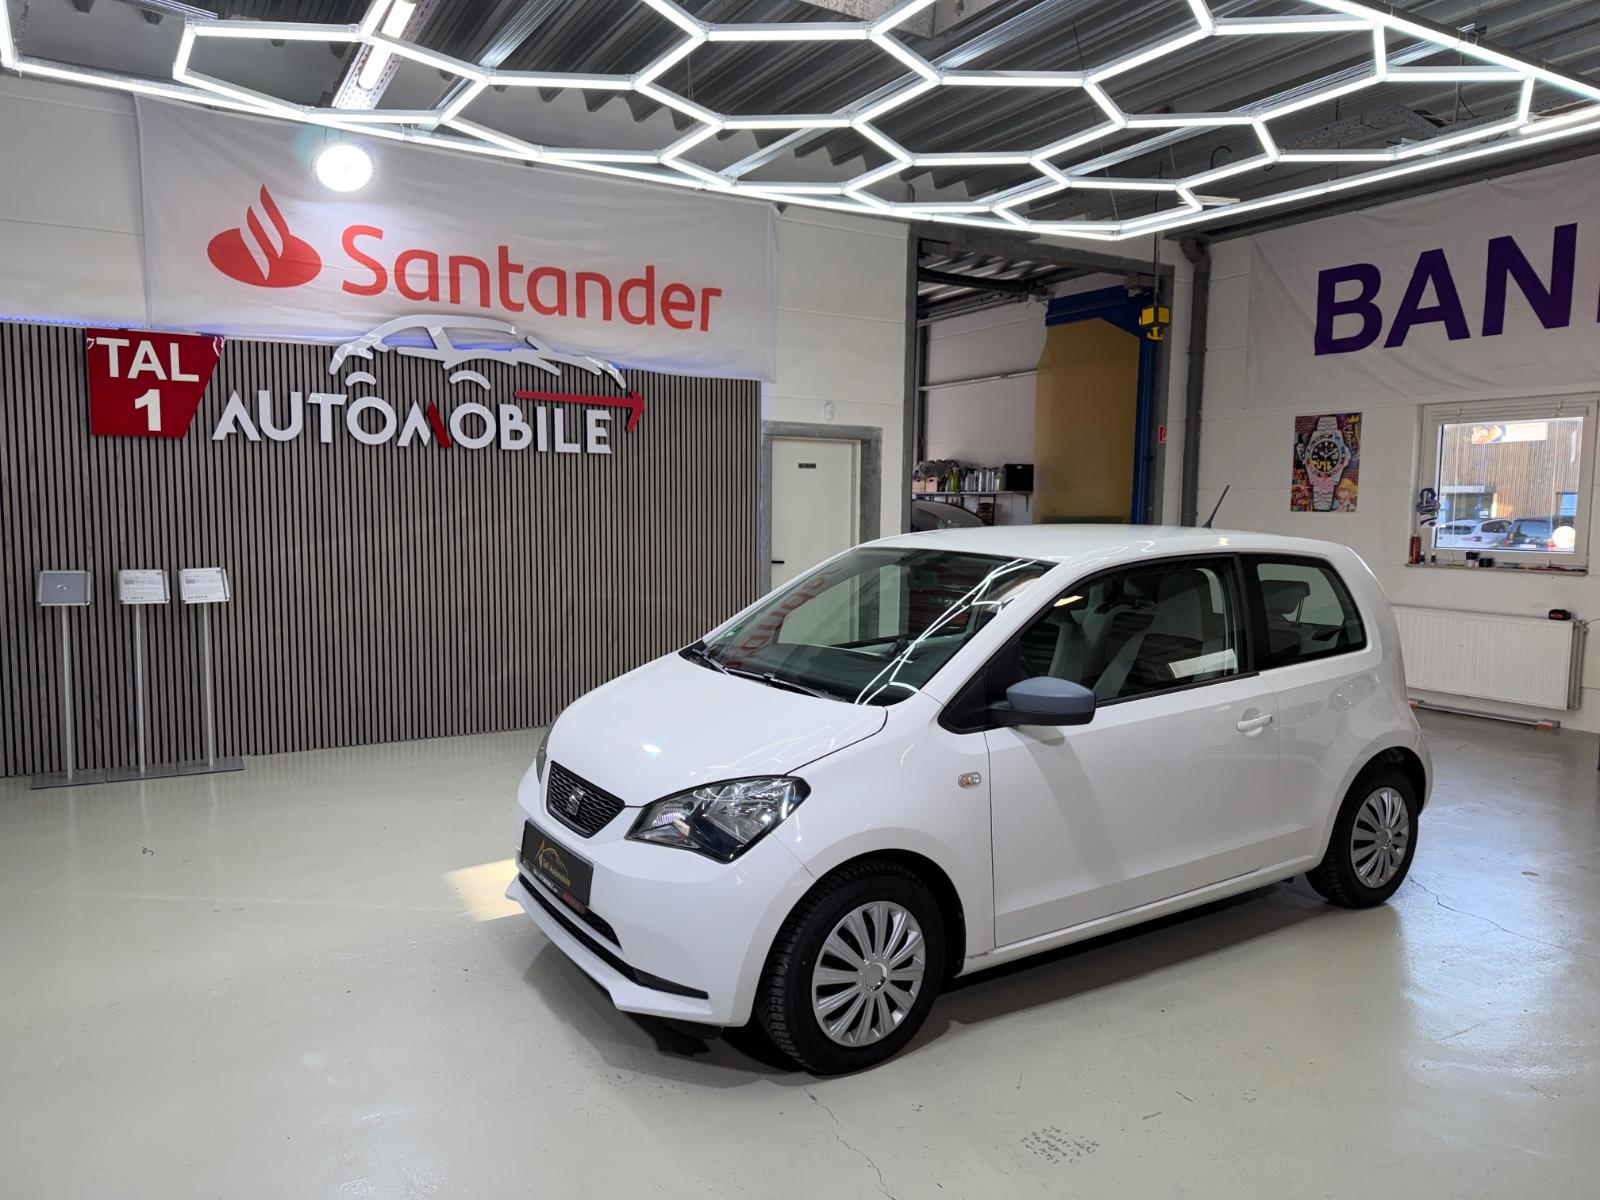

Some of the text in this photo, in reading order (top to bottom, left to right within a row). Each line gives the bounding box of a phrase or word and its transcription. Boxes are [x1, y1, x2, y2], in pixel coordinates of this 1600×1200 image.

[341, 224, 722, 332] Santander
[1314, 222, 1600, 356] BAN
[96, 336, 200, 383] TAL
[134, 388, 162, 432] 1
[212, 389, 613, 454] AUTOMOBILE
